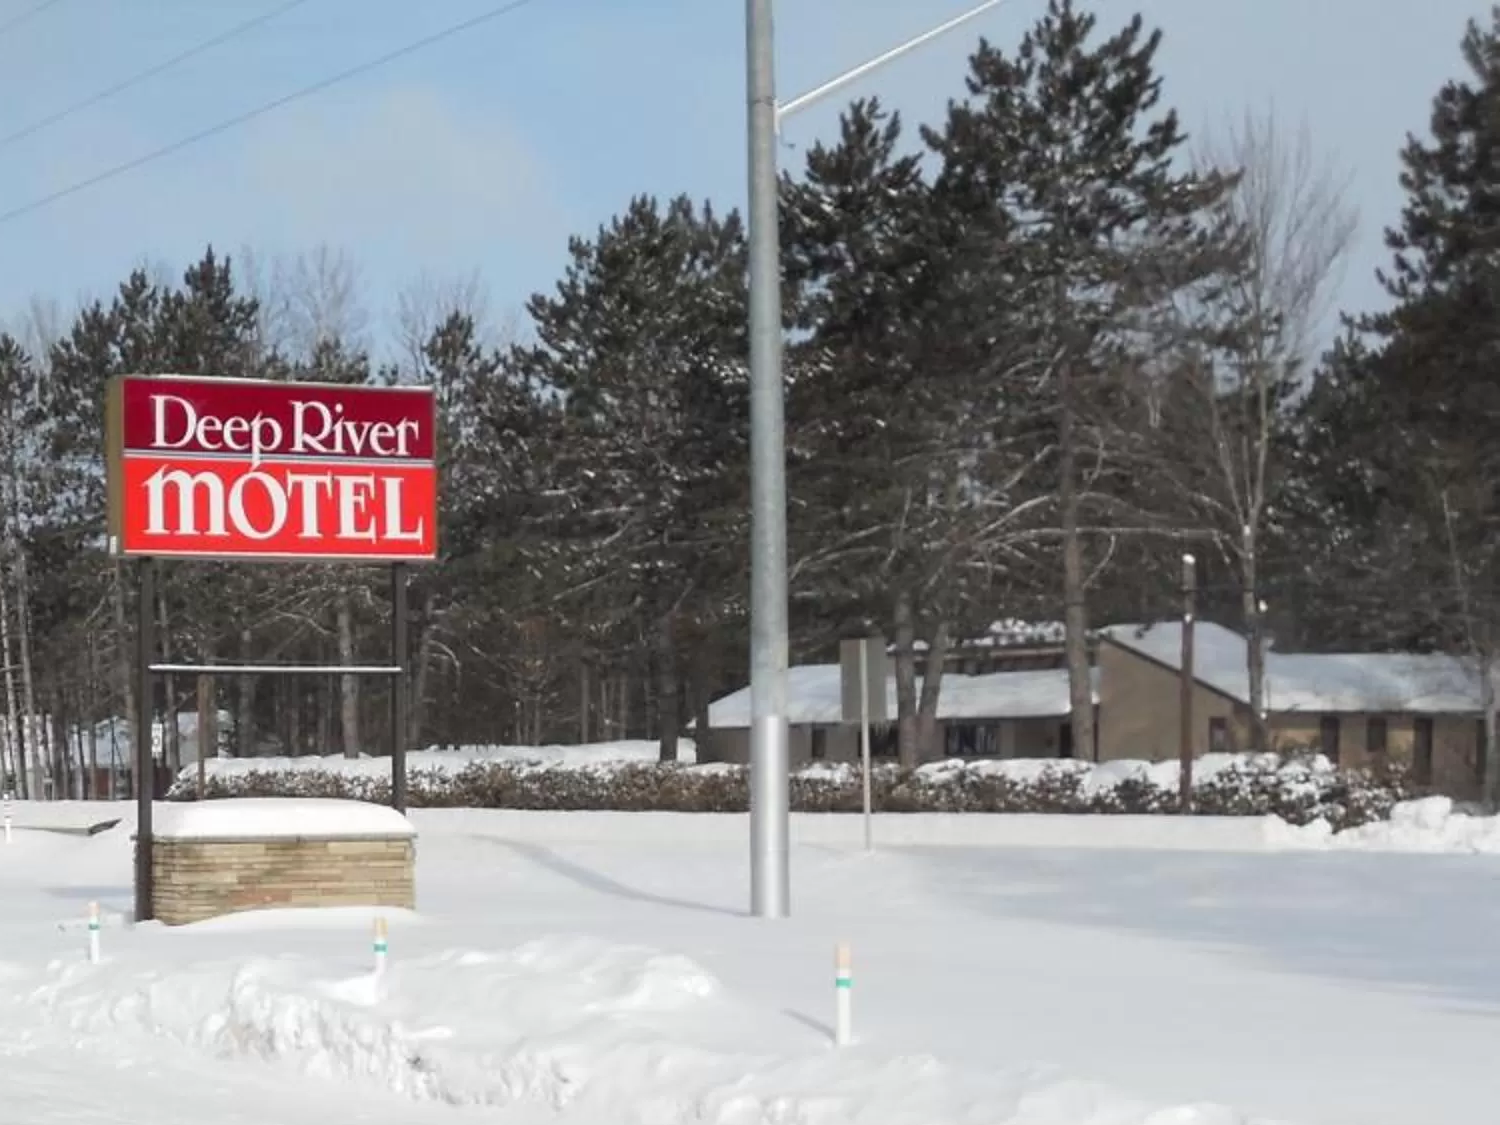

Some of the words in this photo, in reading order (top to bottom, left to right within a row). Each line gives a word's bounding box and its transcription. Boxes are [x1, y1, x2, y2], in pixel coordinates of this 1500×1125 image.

[150, 394, 283, 472] Deep
[290, 400, 420, 457] River
[142, 464, 424, 545] MOTEL
